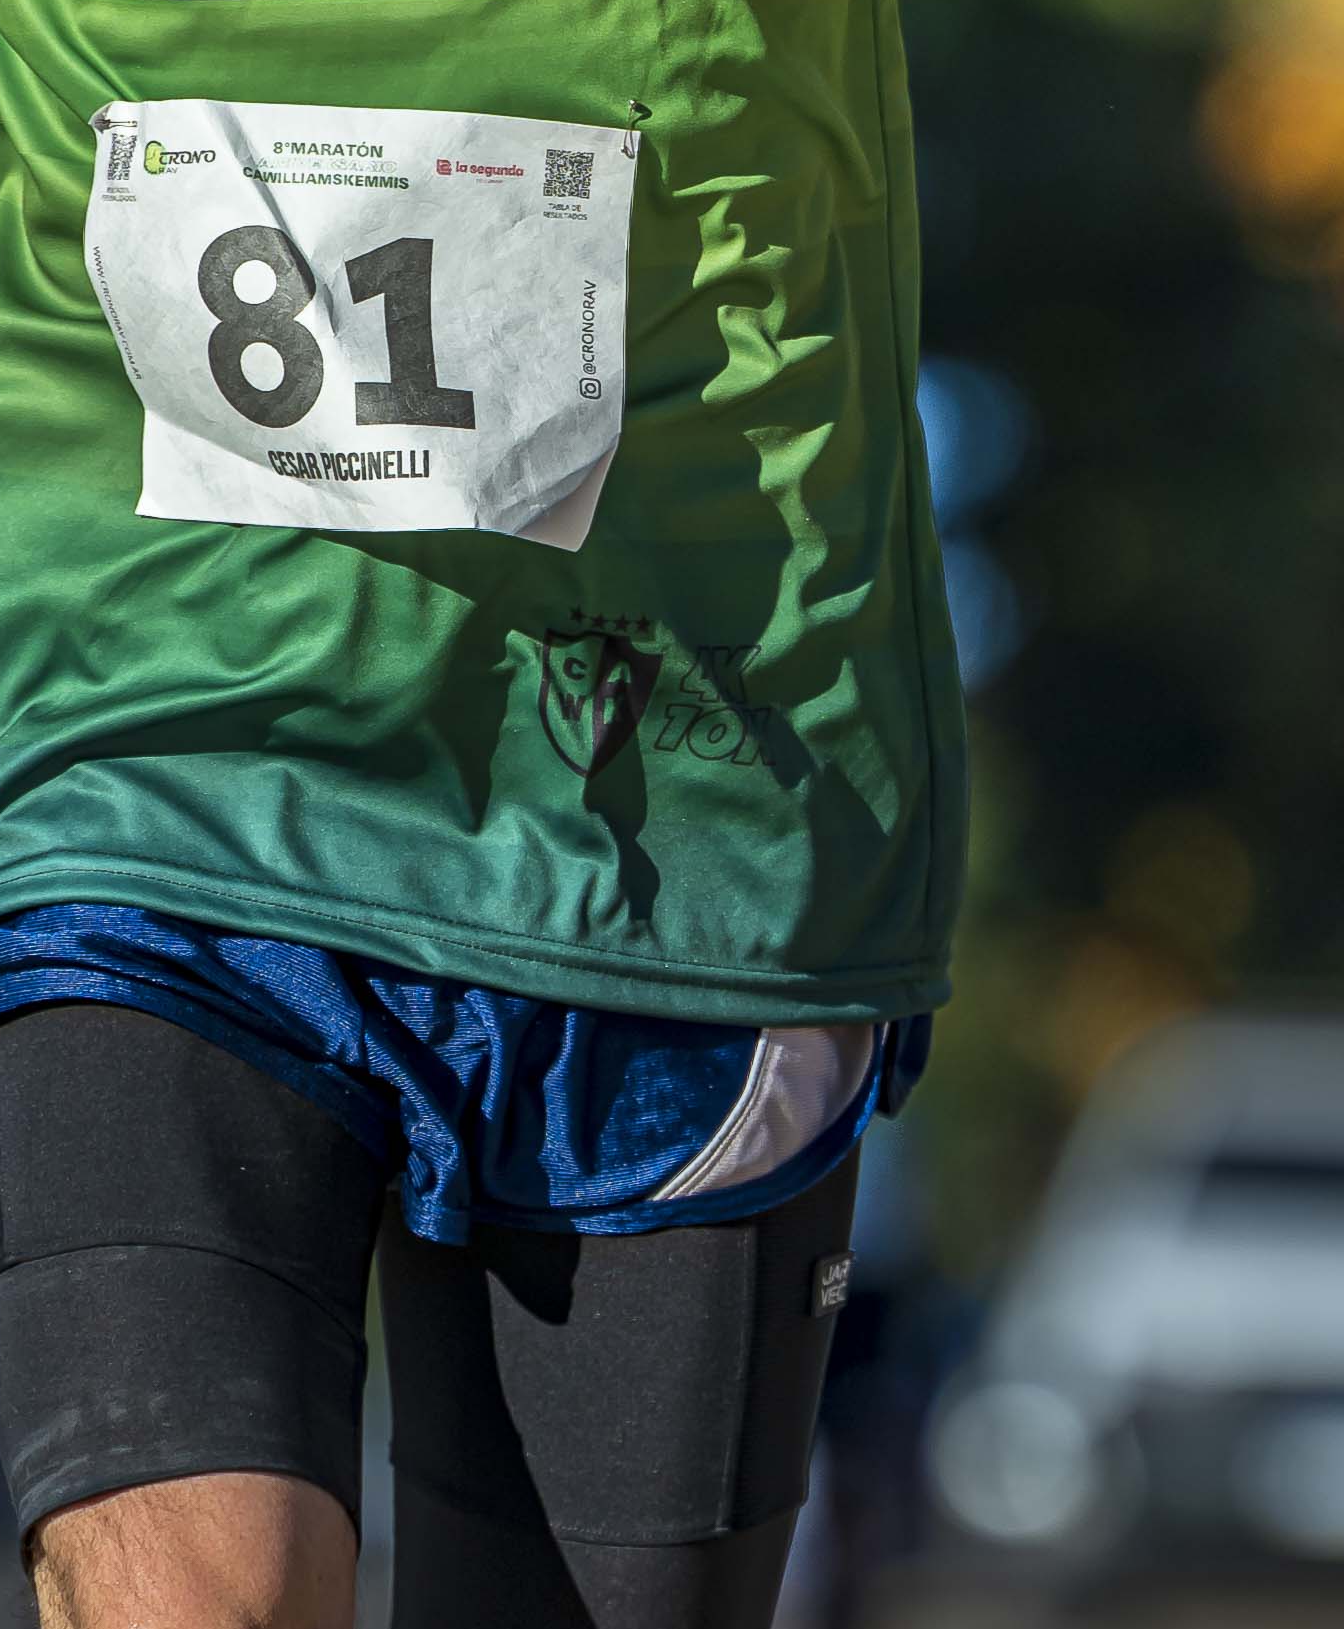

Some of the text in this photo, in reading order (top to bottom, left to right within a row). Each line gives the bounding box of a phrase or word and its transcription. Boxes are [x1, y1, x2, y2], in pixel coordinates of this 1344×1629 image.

[242, 166, 410, 190] CAWILLIAMSKEMMIS
[469, 164, 524, 178] segunda
[197, 224, 477, 431] 81
[581, 279, 597, 375] @CRONORAV
[267, 449, 430, 482] CESAR PICCINELLI
